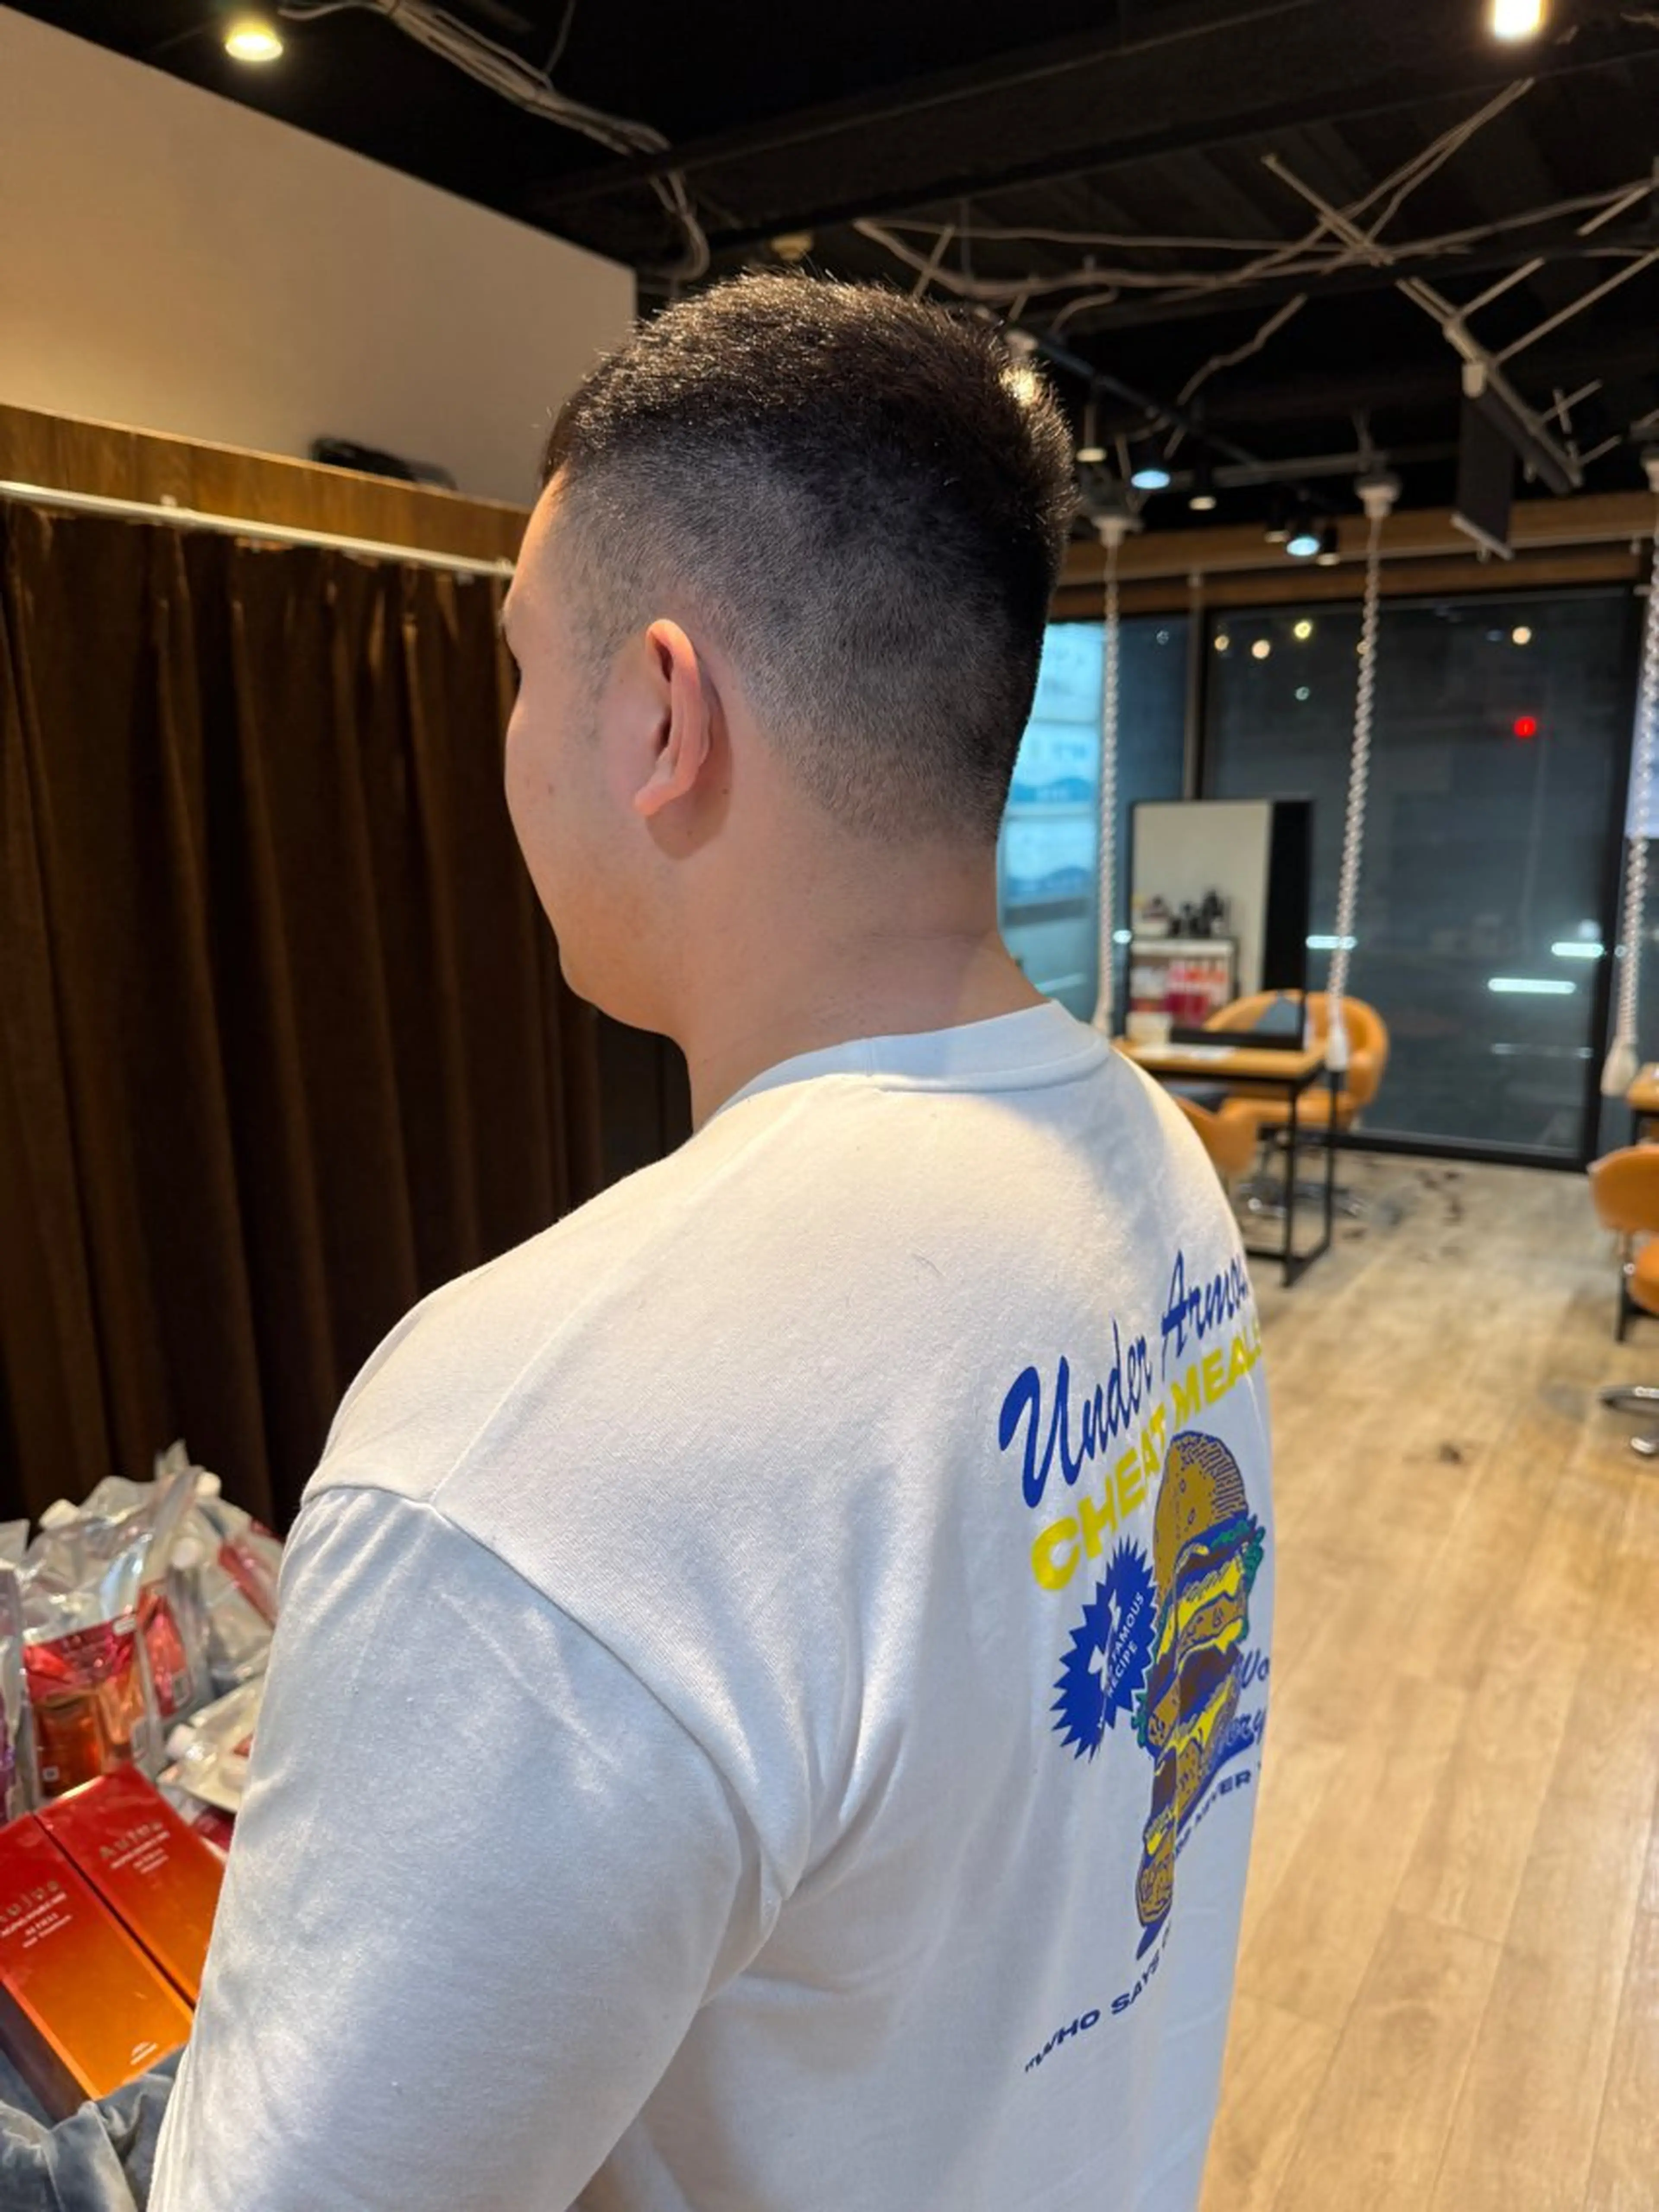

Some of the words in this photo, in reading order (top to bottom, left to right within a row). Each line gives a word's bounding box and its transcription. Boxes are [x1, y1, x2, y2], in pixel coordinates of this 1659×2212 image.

[999, 1313, 1153, 1509] Under
[1031, 1402, 1167, 1591] CHEAT
[1111, 1592, 1145, 1662] FAMOUS
